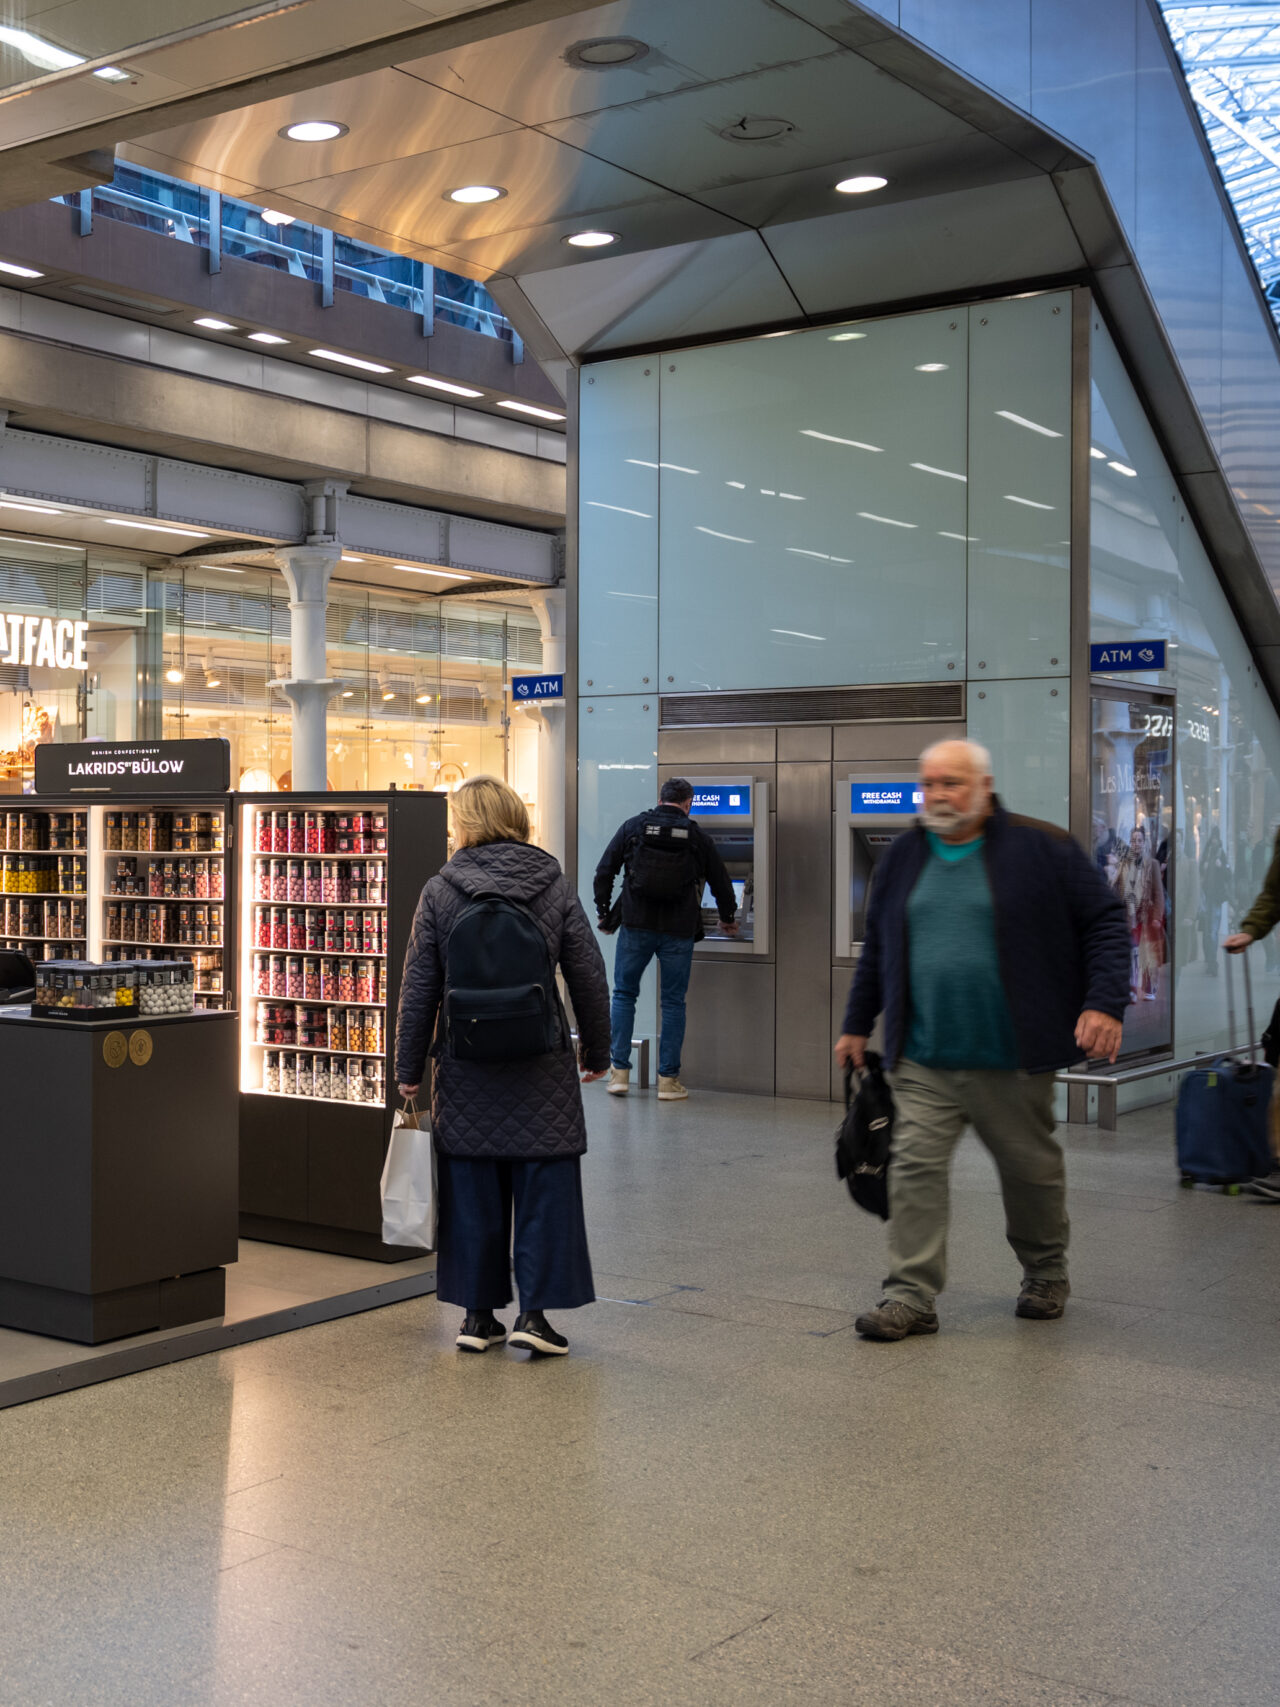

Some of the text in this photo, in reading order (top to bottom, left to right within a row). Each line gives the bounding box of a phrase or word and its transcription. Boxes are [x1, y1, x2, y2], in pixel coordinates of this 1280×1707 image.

[1100, 649, 1132, 663] ATM
[533, 681, 559, 694] ATM
[68, 761, 125, 775] LAKRIDS
[132, 758, 184, 774] BÜLOW
[1100, 765, 1117, 793] Les
[881, 791, 902, 799] CASH
